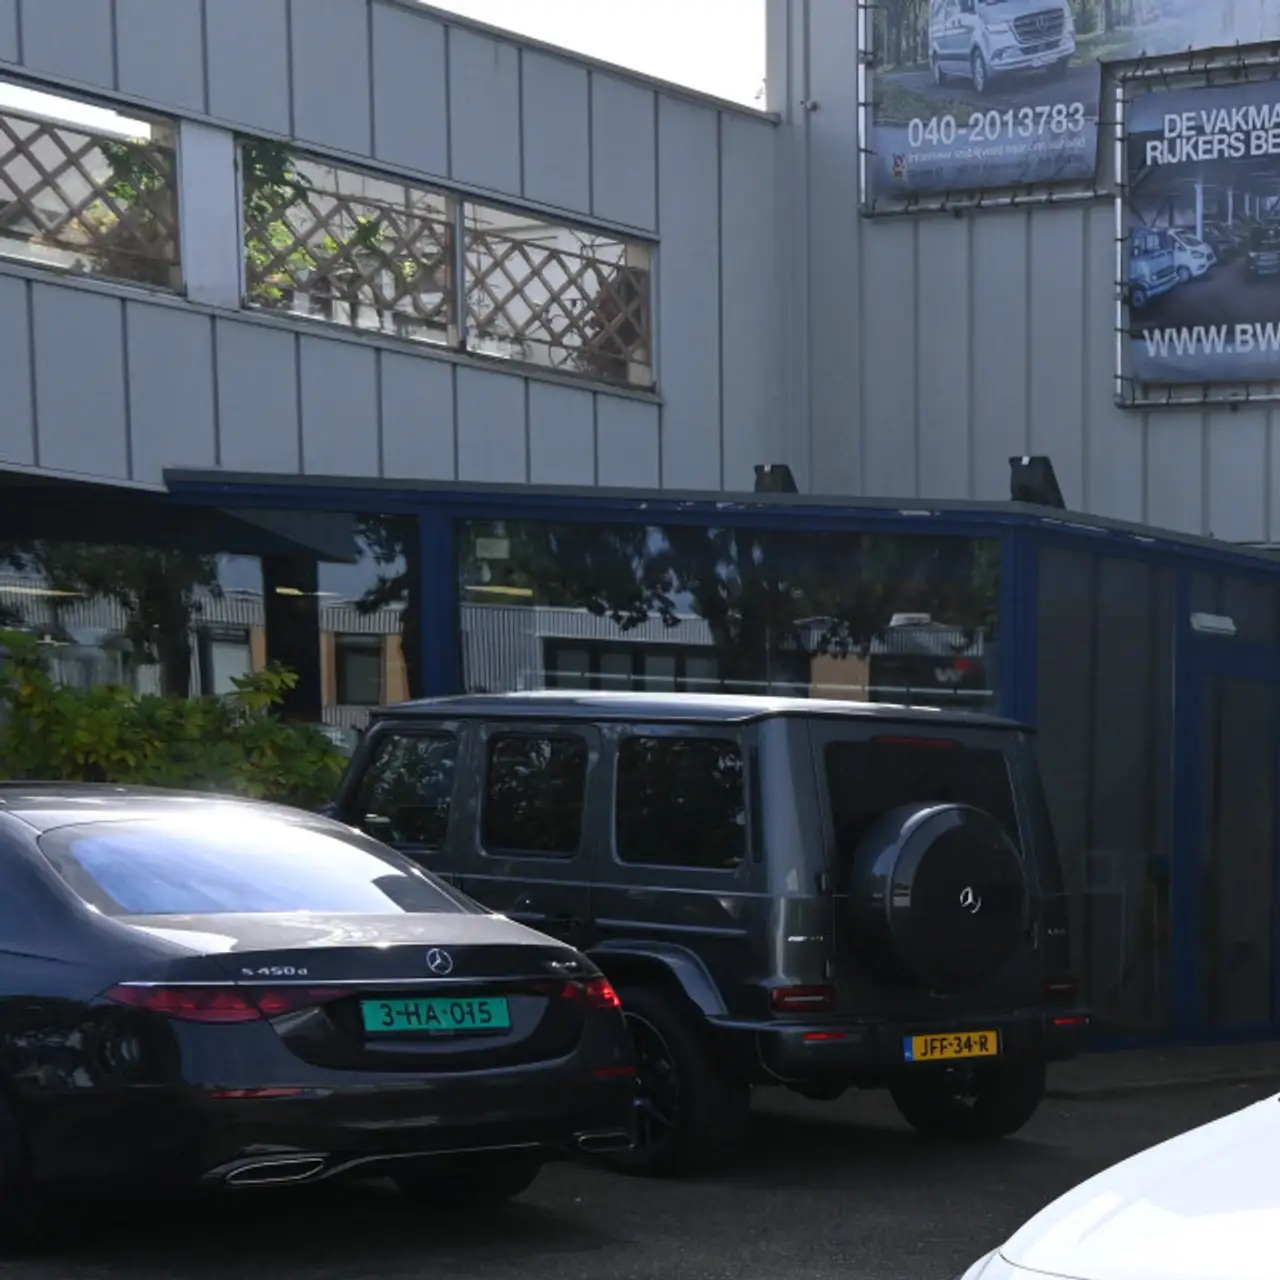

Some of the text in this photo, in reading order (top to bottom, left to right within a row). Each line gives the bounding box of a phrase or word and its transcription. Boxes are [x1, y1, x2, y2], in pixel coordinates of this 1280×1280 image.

[908, 102, 1084, 147] 040-2013783
[1164, 112, 1197, 139] DE
[1146, 132, 1246, 166] RIJKERS
[379, 1001, 493, 1027] 3-HA-015
[920, 1034, 989, 1057] JFF-34-R
